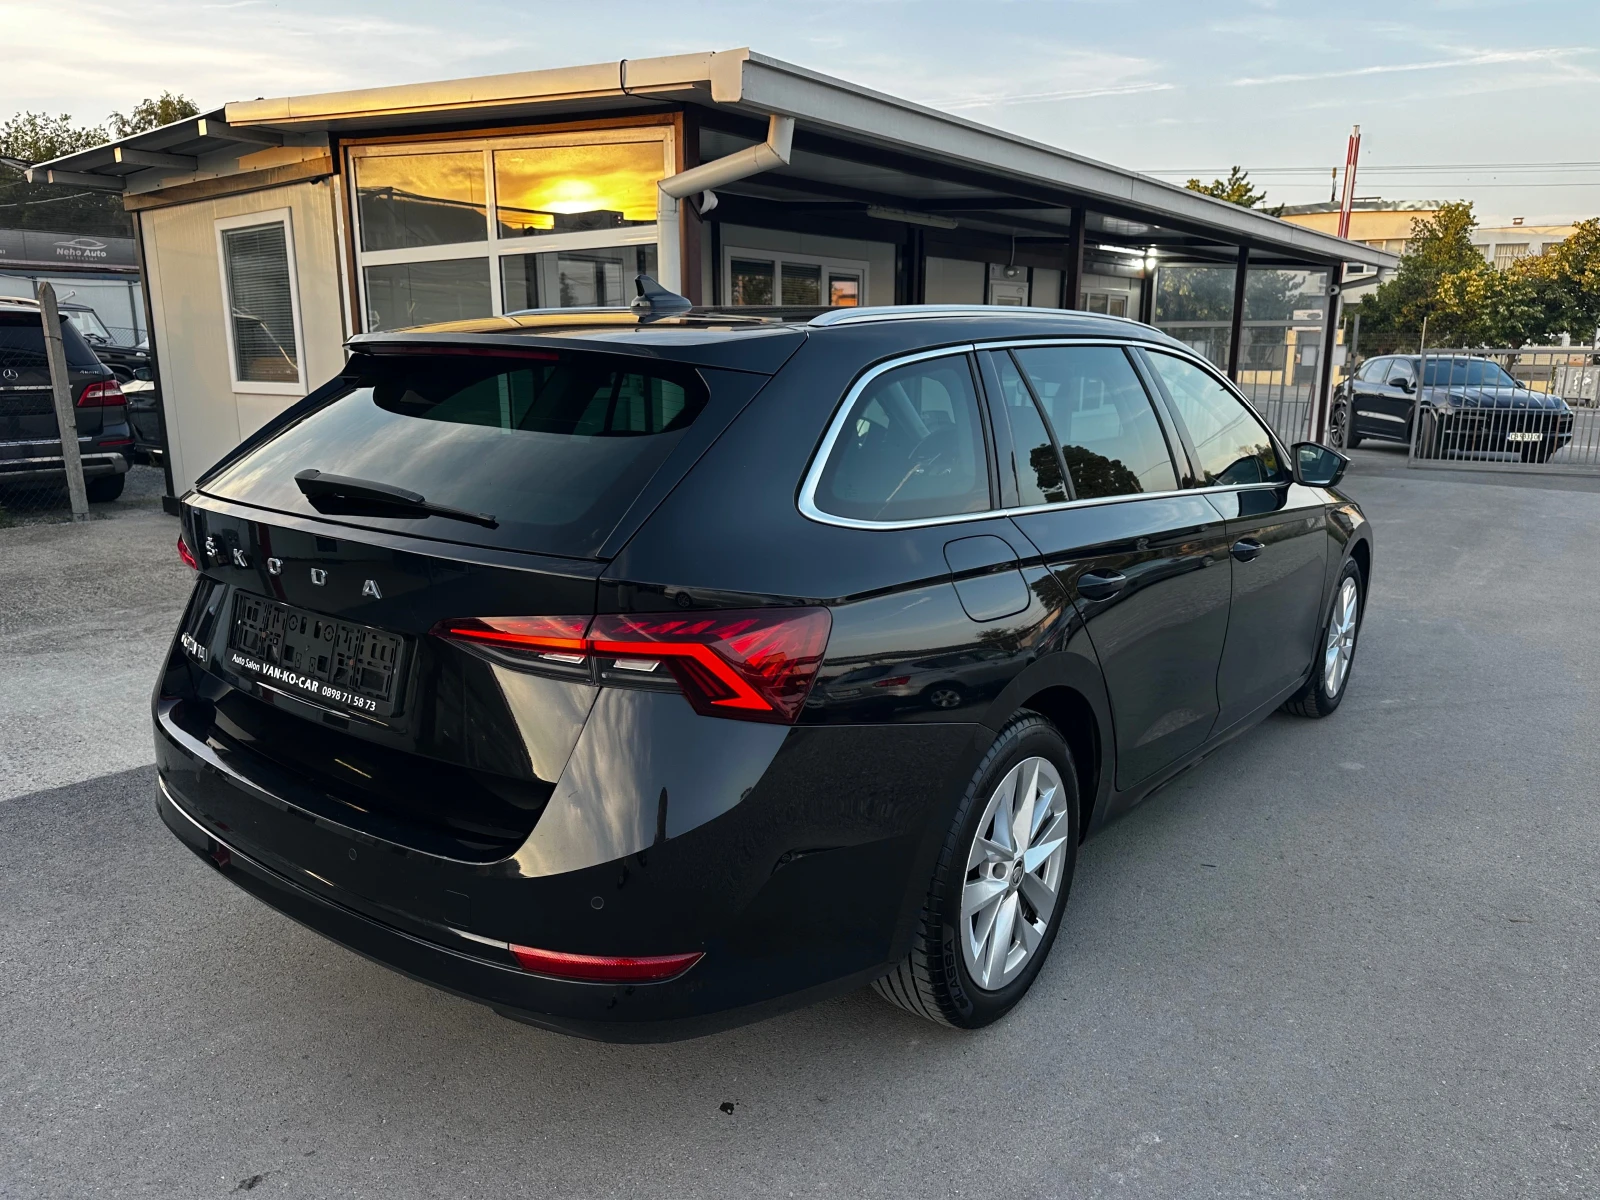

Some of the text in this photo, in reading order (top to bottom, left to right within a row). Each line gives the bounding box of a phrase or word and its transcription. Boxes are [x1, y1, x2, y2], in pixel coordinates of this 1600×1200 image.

[56, 247, 107, 257] Neho Auto
[231, 653, 246, 666] Auto
[245, 658, 261, 672] Salon
[262, 662, 320, 693] VAN-KO-CAR
[321, 686, 342, 701] 0898
[943, 938, 963, 1003] LASSA
